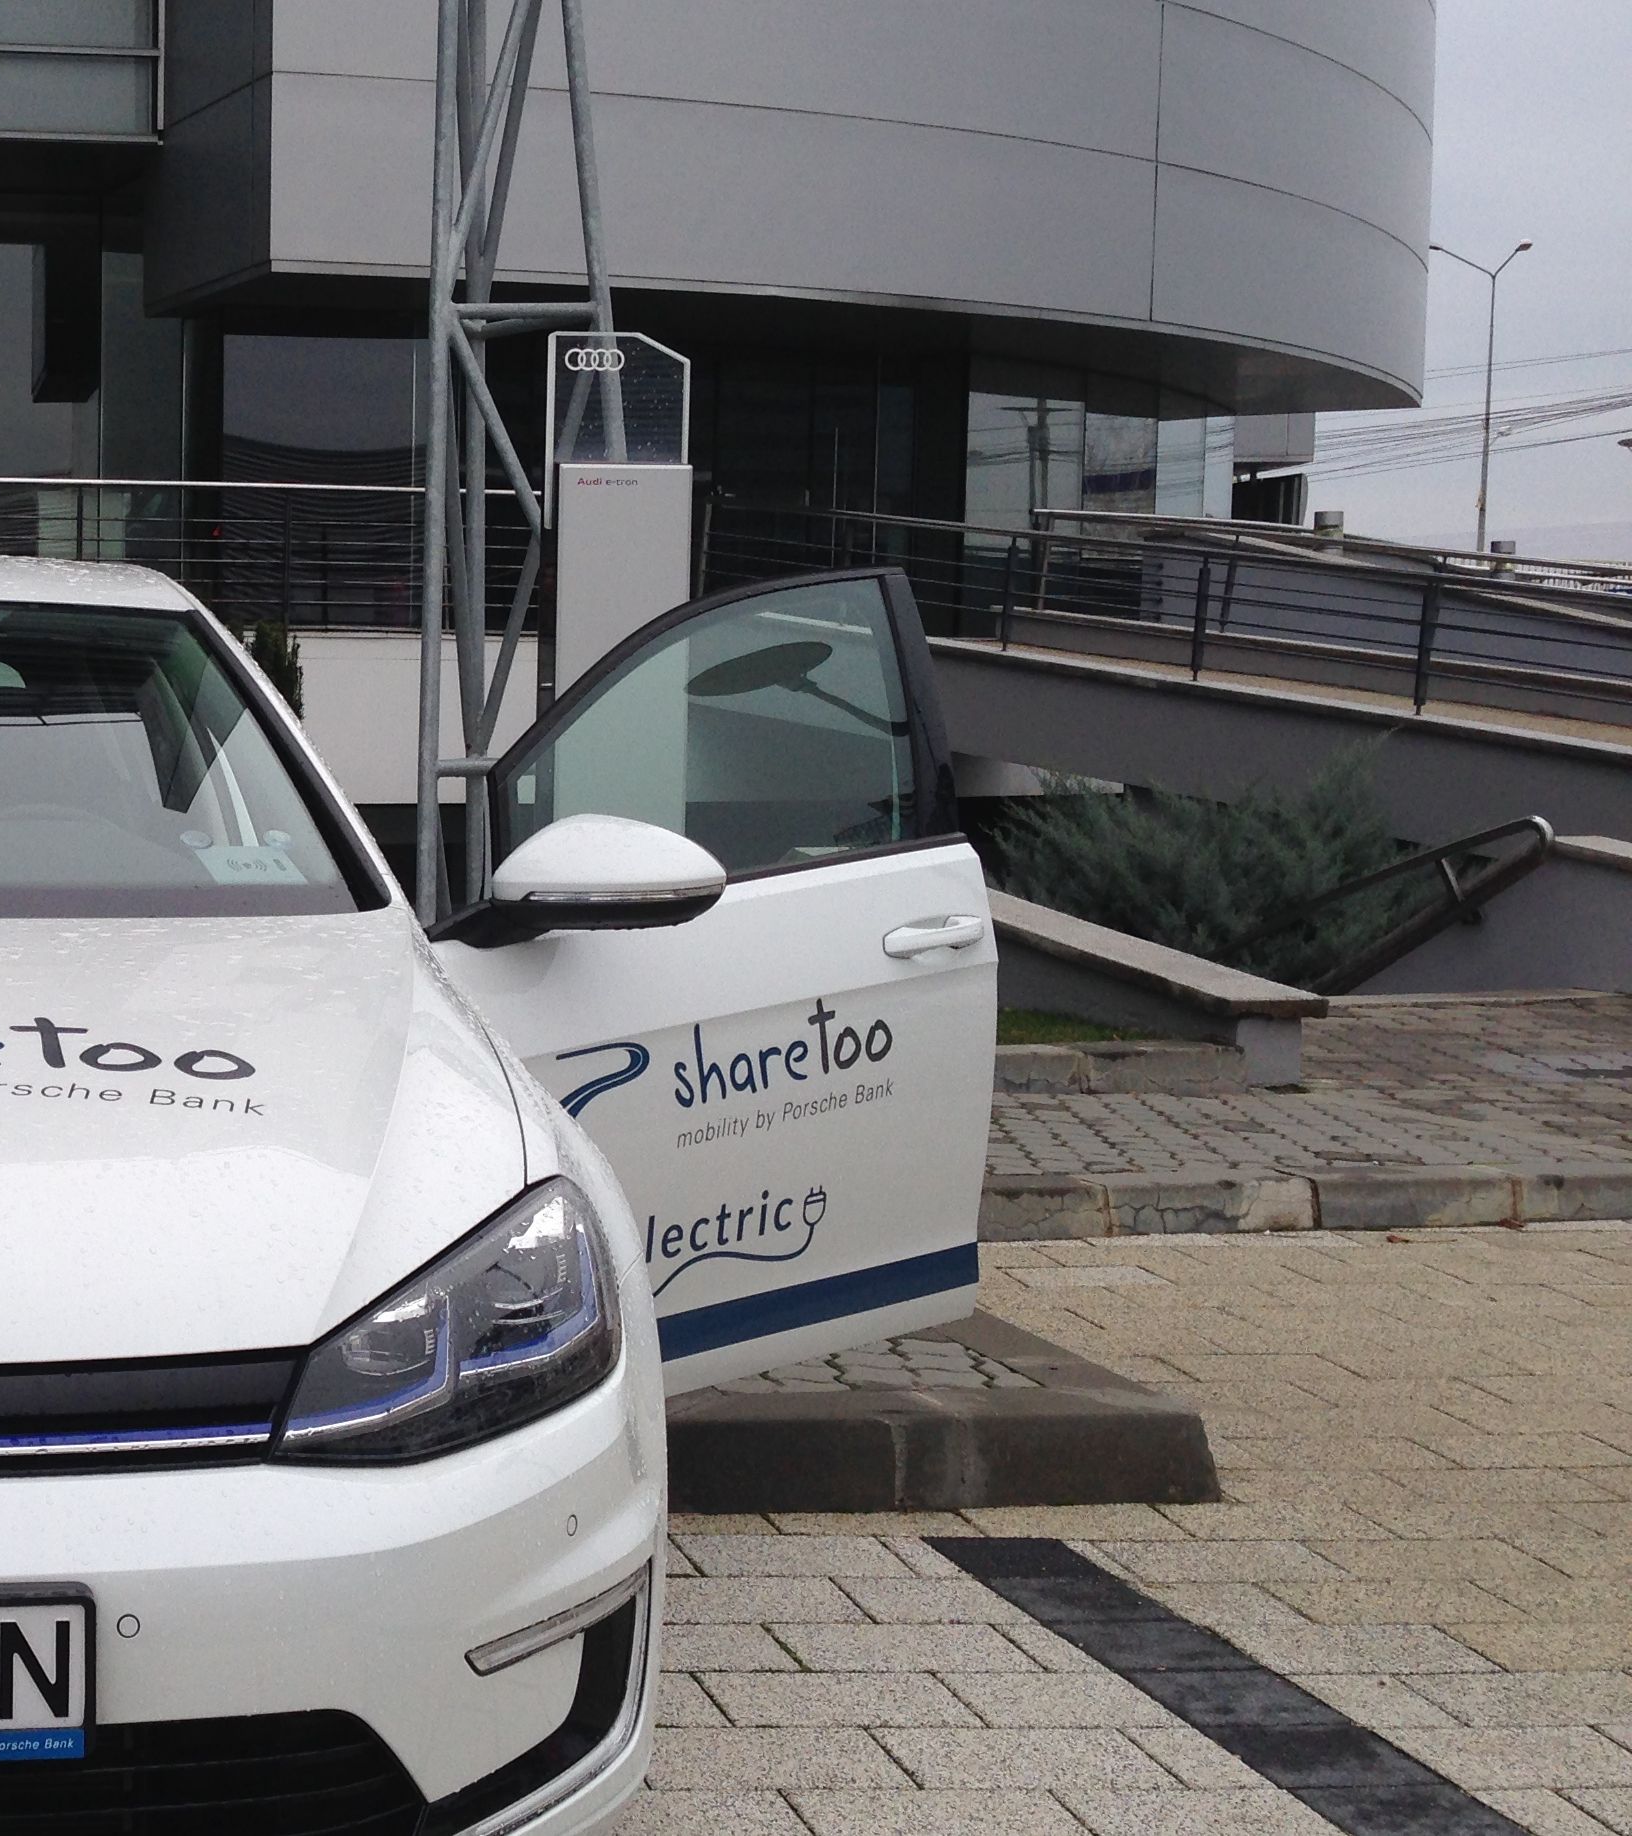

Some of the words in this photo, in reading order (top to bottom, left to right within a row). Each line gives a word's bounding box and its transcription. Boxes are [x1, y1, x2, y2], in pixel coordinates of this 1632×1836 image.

[577, 477, 602, 486] Audi
[605, 478, 639, 486] e-tron
[673, 997, 894, 1108] sharetoo
[148, 1087, 266, 1117] Bank
[676, 1117, 750, 1149] mobility
[755, 1109, 776, 1132] by
[782, 1091, 848, 1123] Porsche
[854, 1077, 895, 1105] Bank
[645, 1189, 794, 1264] lectric
[44, 1737, 75, 1750] Bank
